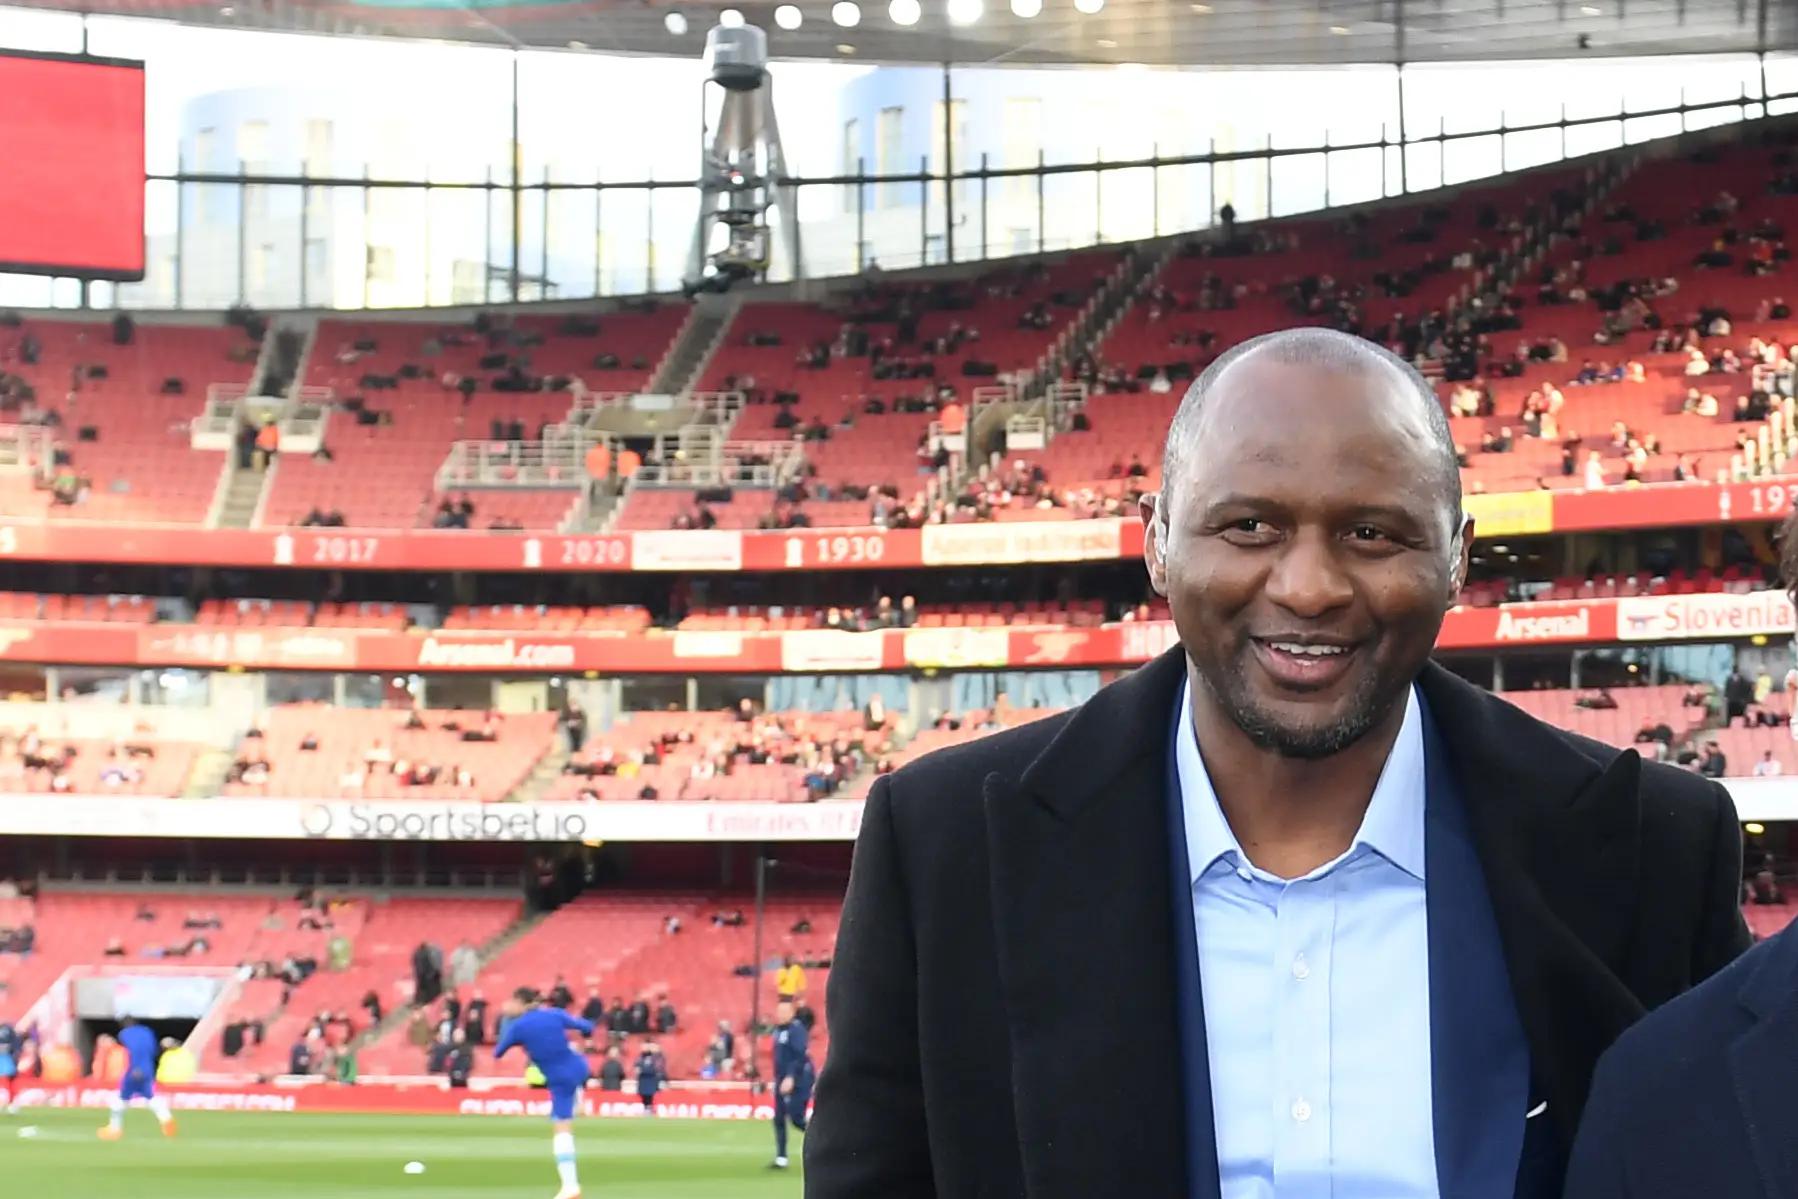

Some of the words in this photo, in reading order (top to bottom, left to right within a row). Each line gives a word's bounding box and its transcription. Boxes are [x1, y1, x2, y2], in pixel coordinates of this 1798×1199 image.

[313, 537, 378, 562] 2017
[561, 540, 625, 564] 2020
[816, 536, 884, 561] 1930
[1495, 608, 1589, 640] Arsenal
[1664, 599, 1791, 633] Slovenia
[417, 636, 575, 666] Arsenal.com
[350, 803, 587, 839] Sportsbet.io
